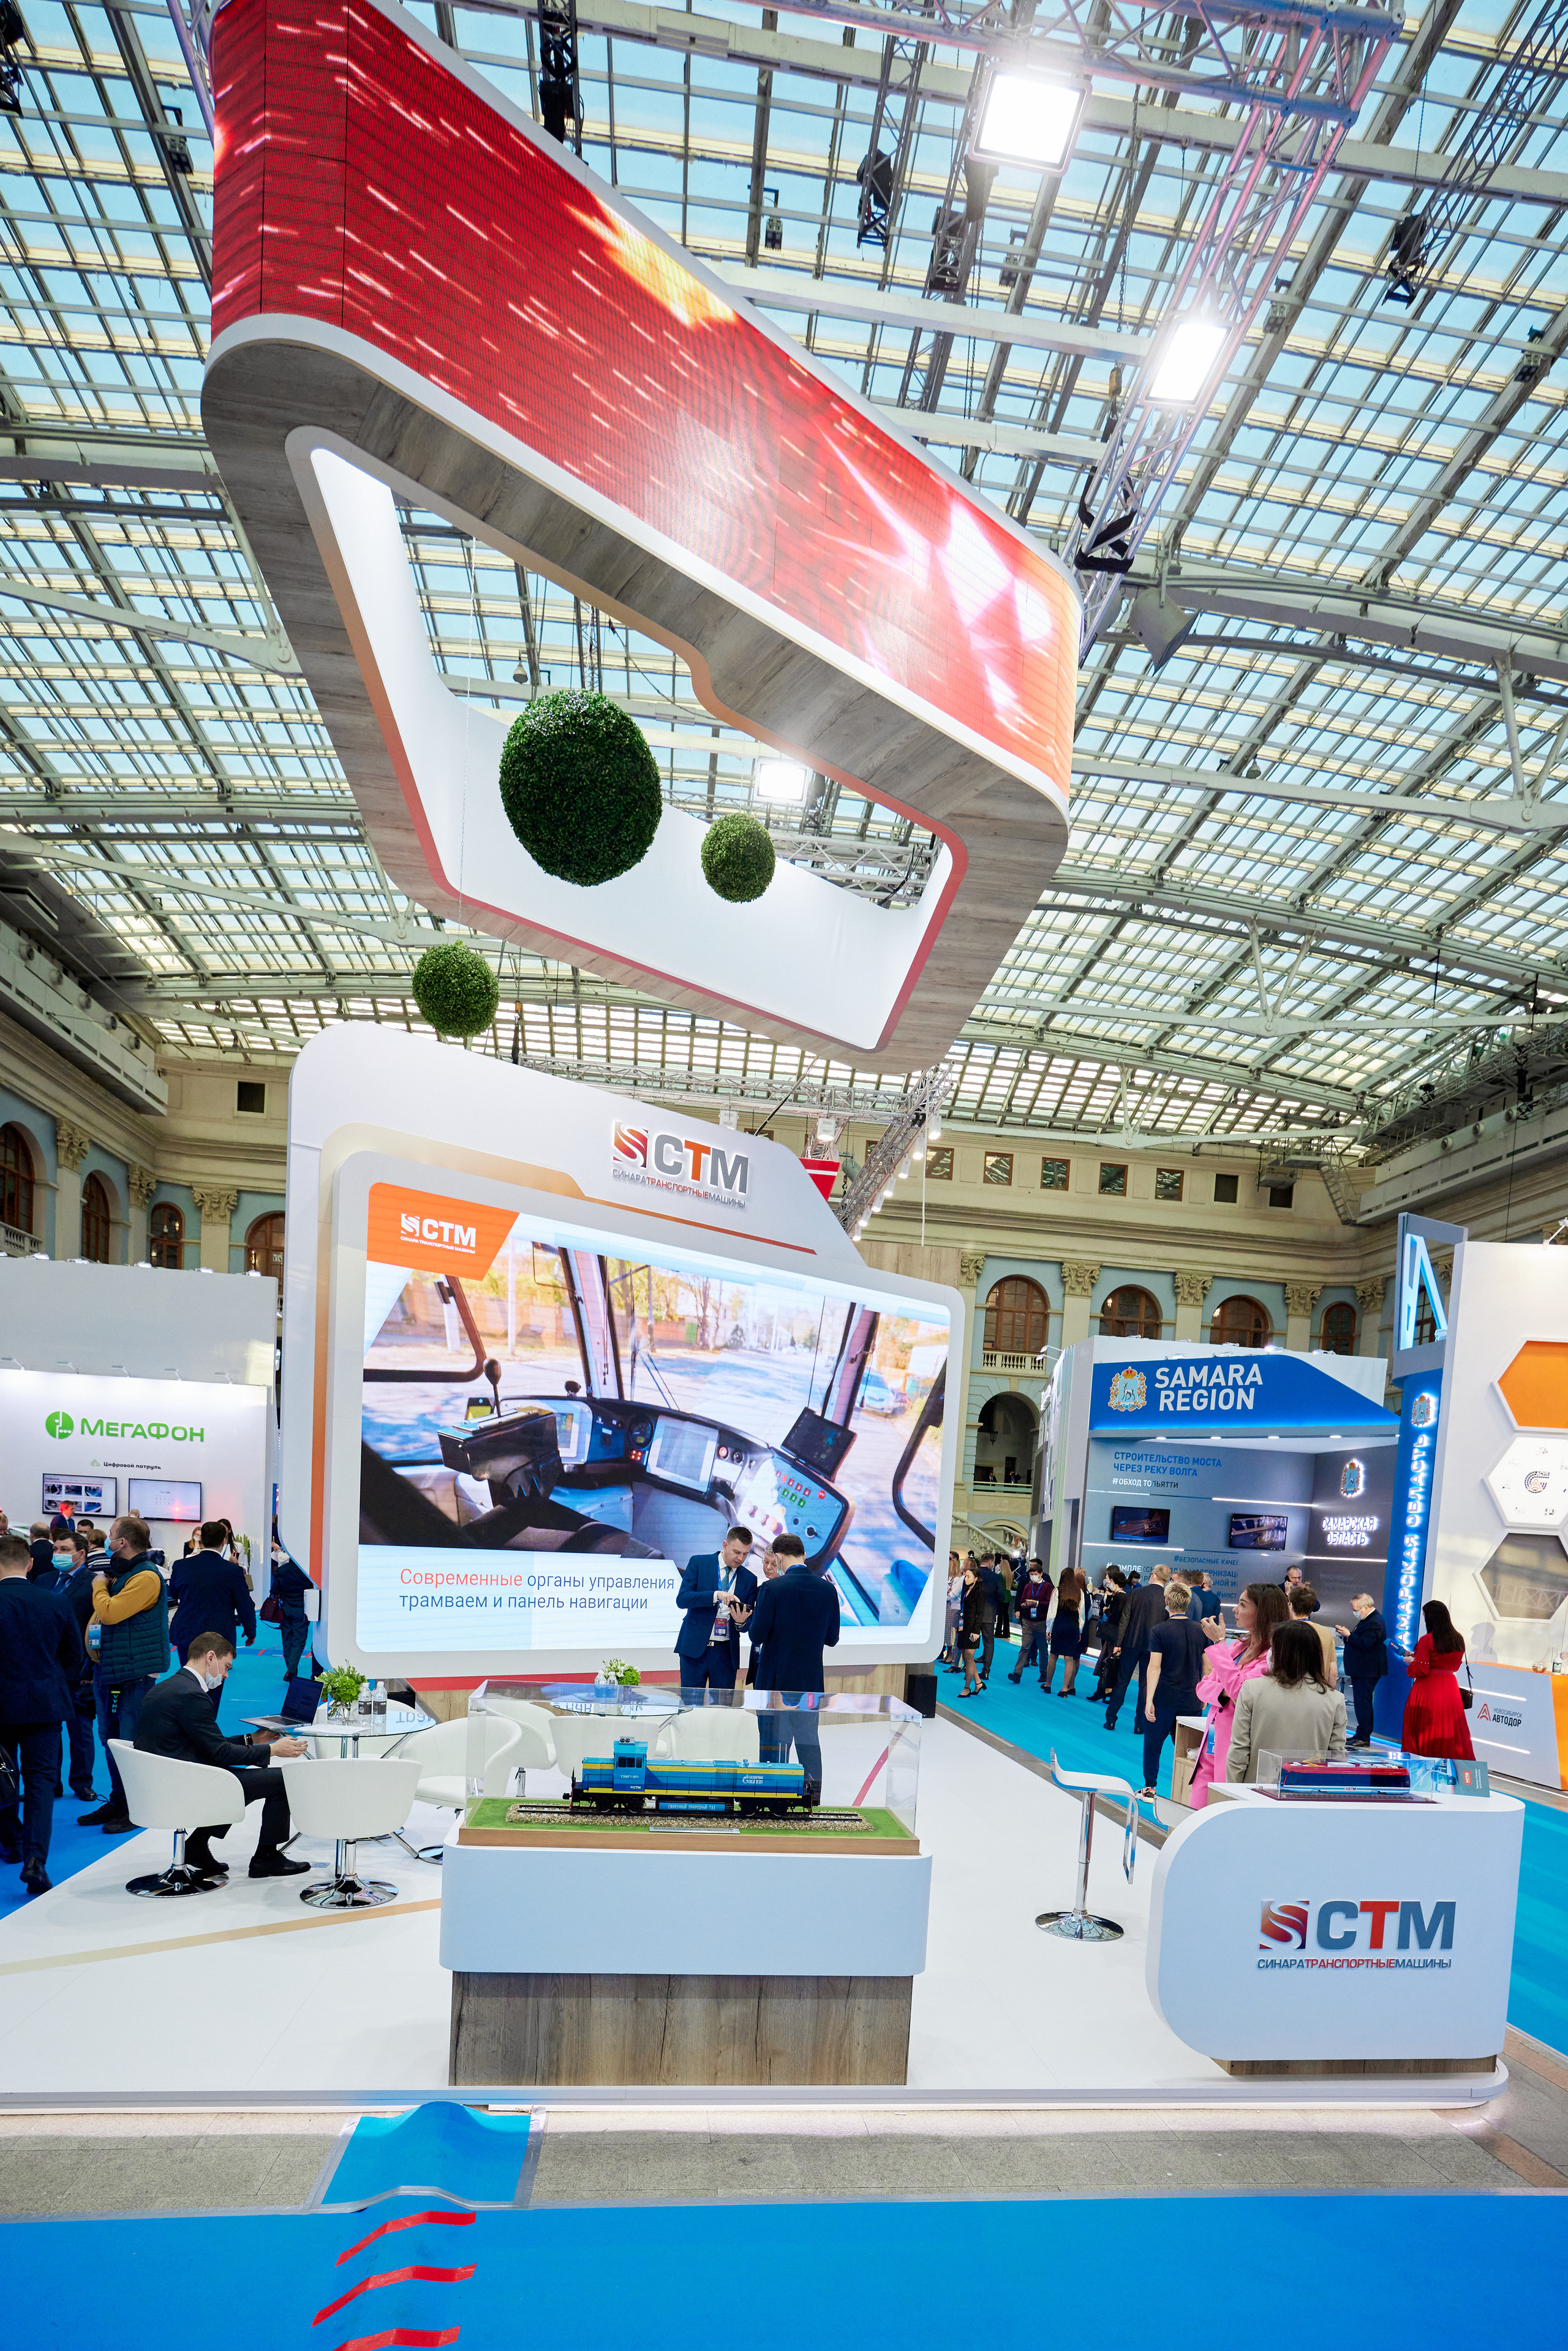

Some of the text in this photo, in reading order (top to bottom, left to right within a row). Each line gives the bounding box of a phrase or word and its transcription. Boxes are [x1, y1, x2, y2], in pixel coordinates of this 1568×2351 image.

[654, 1133, 749, 1194] СТМ
[422, 1218, 476, 1248] СТМ
[400, 1236, 475, 1255] СИНАРА ТРАНСПОРТНЫЕ МАШИНЫ
[1155, 1364, 1263, 1388] SAMARA
[1159, 1387, 1255, 1411] REGION
[1114, 1451, 1222, 1468] СТРОИТЕЛЬСТВО МОСТА
[1113, 1463, 1198, 1477] ЧЕРЕЗ РЕКУ ВОЛГА
[1143, 1479, 1179, 1489] ТОЛЬЯТТИ
[1322, 1517, 1376, 1531] САМАРСКАЯ
[1327, 1531, 1367, 1545] ОБЛАСТЬ
[1395, 1434, 1427, 1646] АМАРСКАЯ ОБЛАСТЬ
[401, 1568, 674, 1591] Современные органы управления
[399, 1595, 648, 1612] трамваем и панель навигации
[1492, 1713, 1522, 1727] АВТОДОР
[1493, 1707, 1523, 1718] НОВОСИБИРСК
[1316, 1900, 1457, 1950] СТМ
